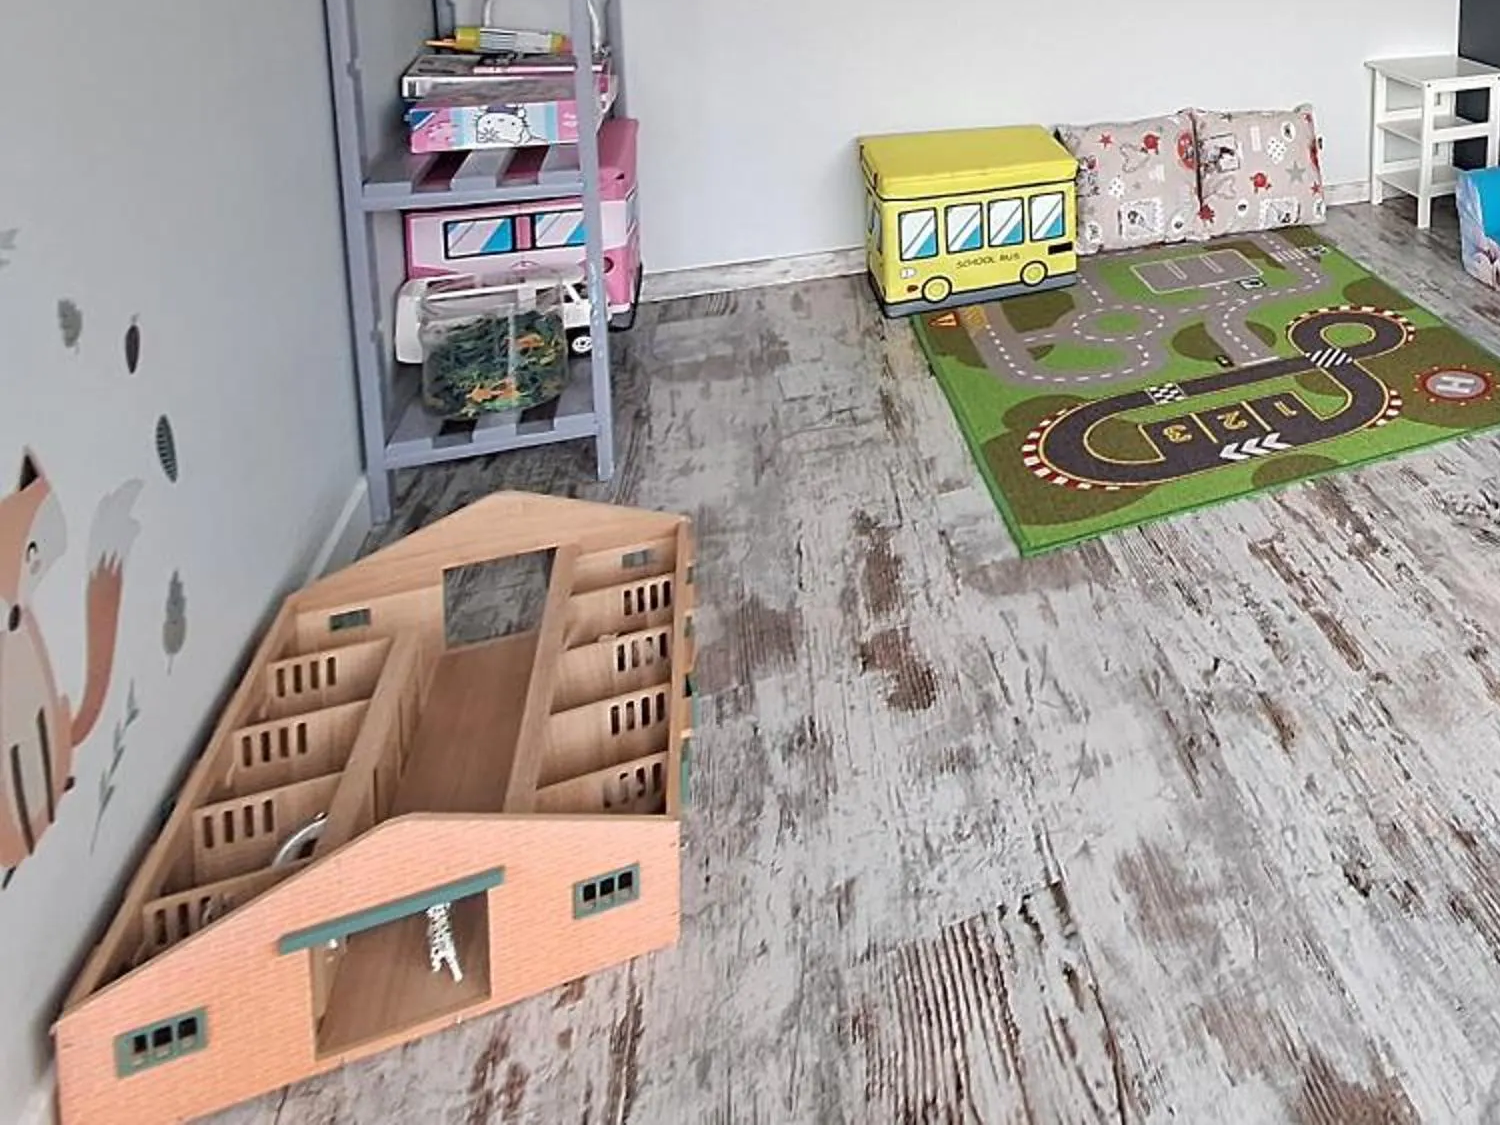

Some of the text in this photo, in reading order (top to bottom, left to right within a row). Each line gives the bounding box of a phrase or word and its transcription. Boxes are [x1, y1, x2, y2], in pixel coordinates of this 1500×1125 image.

[955, 252, 1021, 269] SCHOOL BUS
[1217, 410, 1248, 430] 2
[1163, 425, 1193, 443] 3
